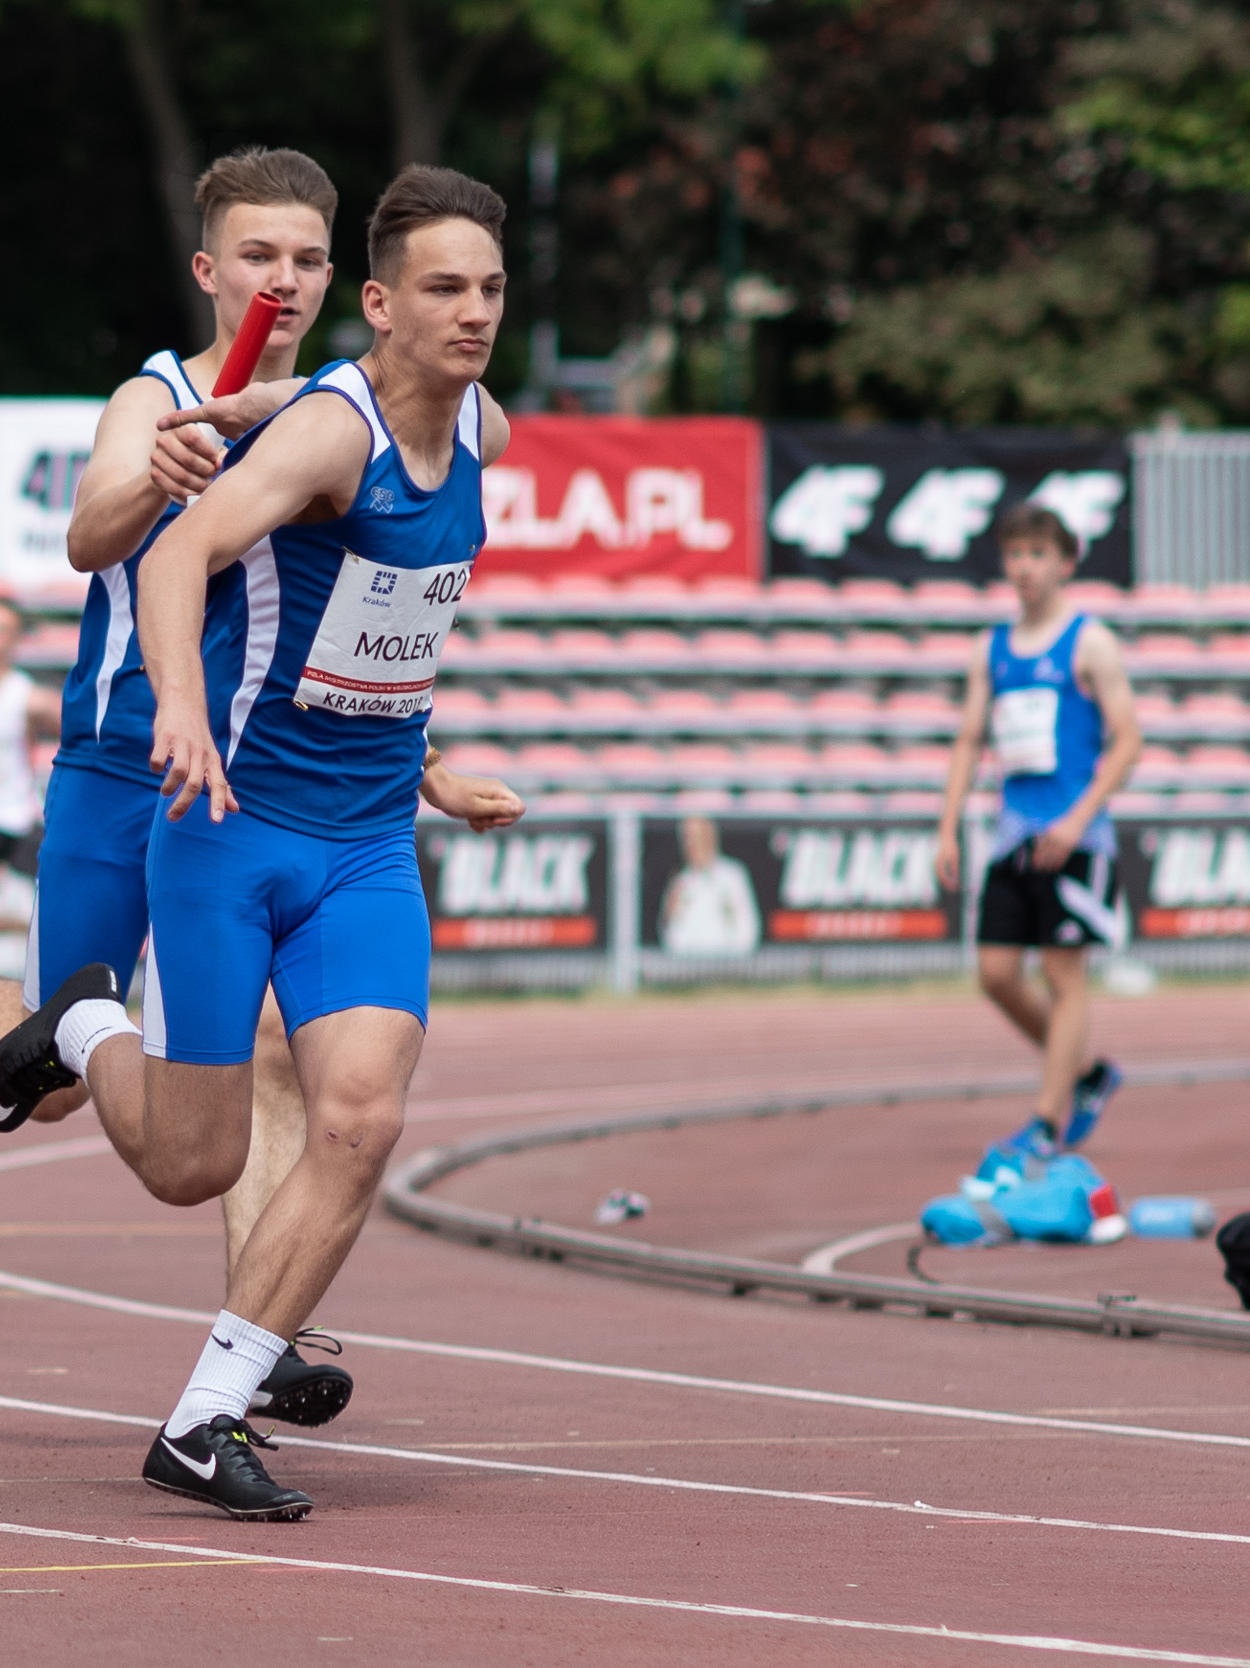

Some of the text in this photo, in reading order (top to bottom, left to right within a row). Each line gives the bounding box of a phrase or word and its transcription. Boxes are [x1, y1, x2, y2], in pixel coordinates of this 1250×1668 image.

[771, 463, 883, 559] 4F
[887, 466, 1006, 562] 4F
[362, 596, 392, 608] Kraków
[423, 568, 468, 605] 402
[353, 631, 439, 661] MOLEK
[322, 691, 396, 713] KRAKÓW
[436, 832, 594, 914] BLACK
